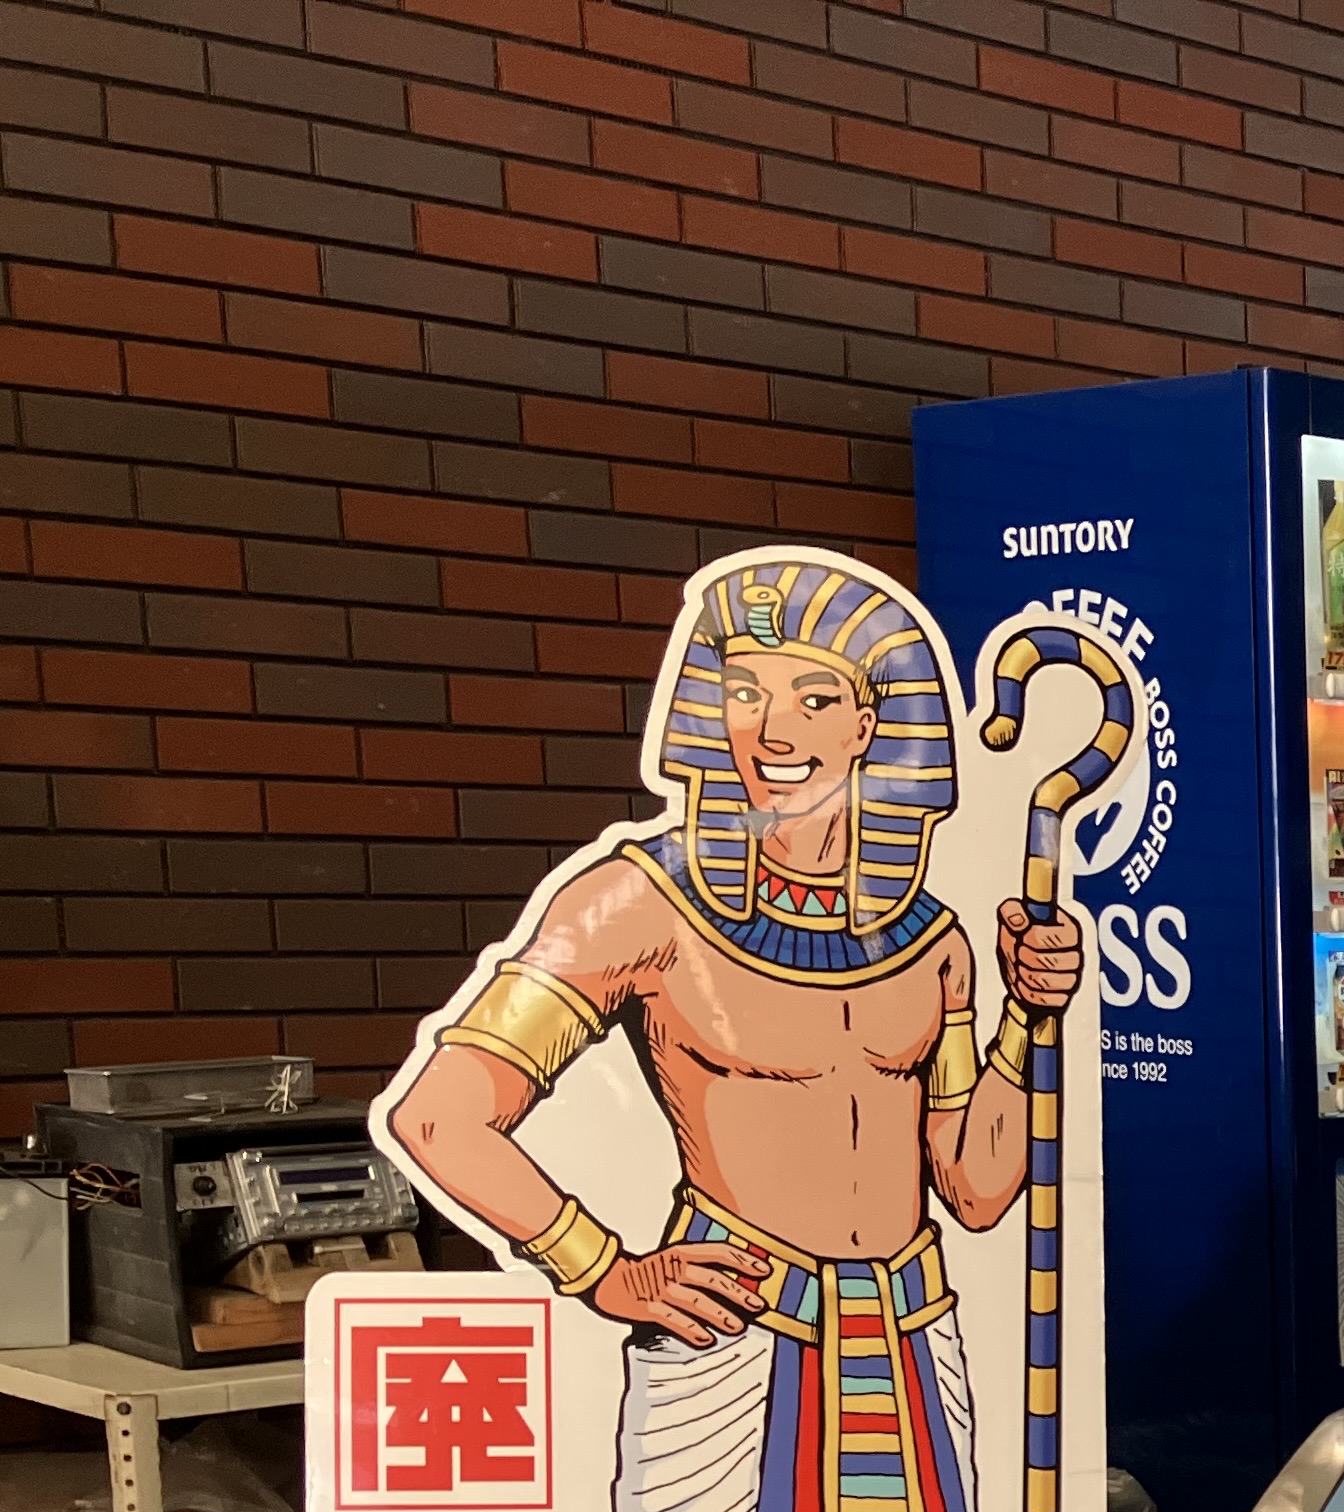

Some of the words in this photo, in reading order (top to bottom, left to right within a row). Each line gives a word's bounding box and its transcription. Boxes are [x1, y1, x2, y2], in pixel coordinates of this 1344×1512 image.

[1002, 518, 1135, 558] SUNTORY
[1144, 677, 1177, 769] BOSS
[1120, 780, 1177, 895] COFFEE
[1098, 903, 1191, 1010] SS
[1102, 1062, 1129, 1080] nce
[1132, 1061, 1168, 1082] 1992
[1115, 1031, 1128, 1051] is
[1130, 1032, 1154, 1053] the
[1157, 1034, 1193, 1056] boss
